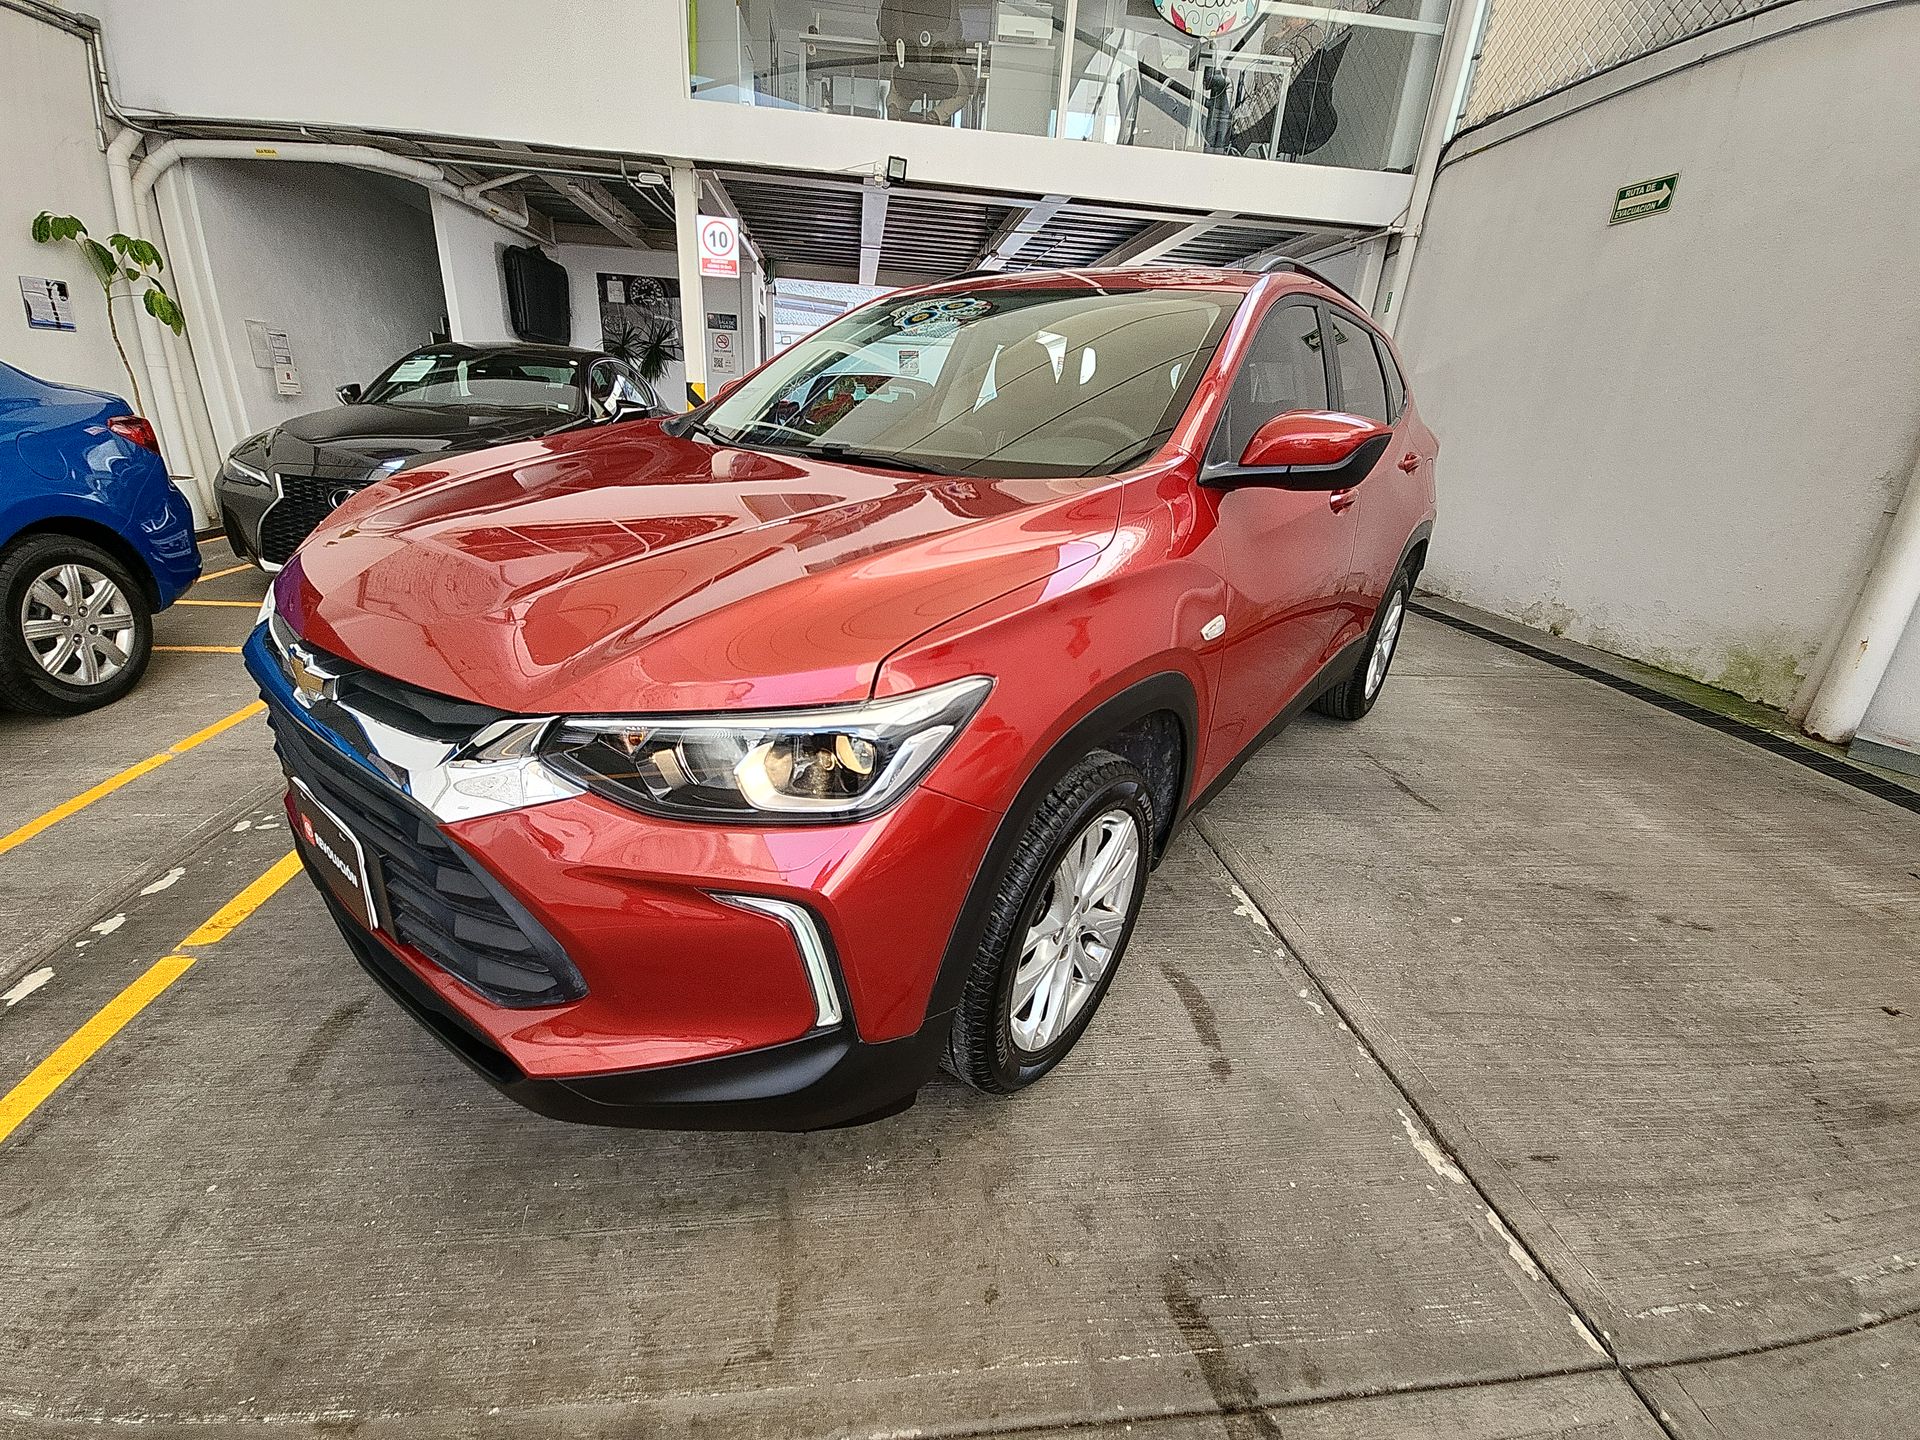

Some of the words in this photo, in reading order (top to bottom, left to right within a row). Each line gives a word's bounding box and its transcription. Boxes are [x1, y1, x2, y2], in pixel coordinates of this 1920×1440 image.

[1625, 187, 1645, 197] RUTA
[1645, 183, 1657, 193] DE
[1614, 202, 1657, 219] EVACUACION
[709, 230, 728, 248] 10
[1137, 791, 1154, 822] AVID
